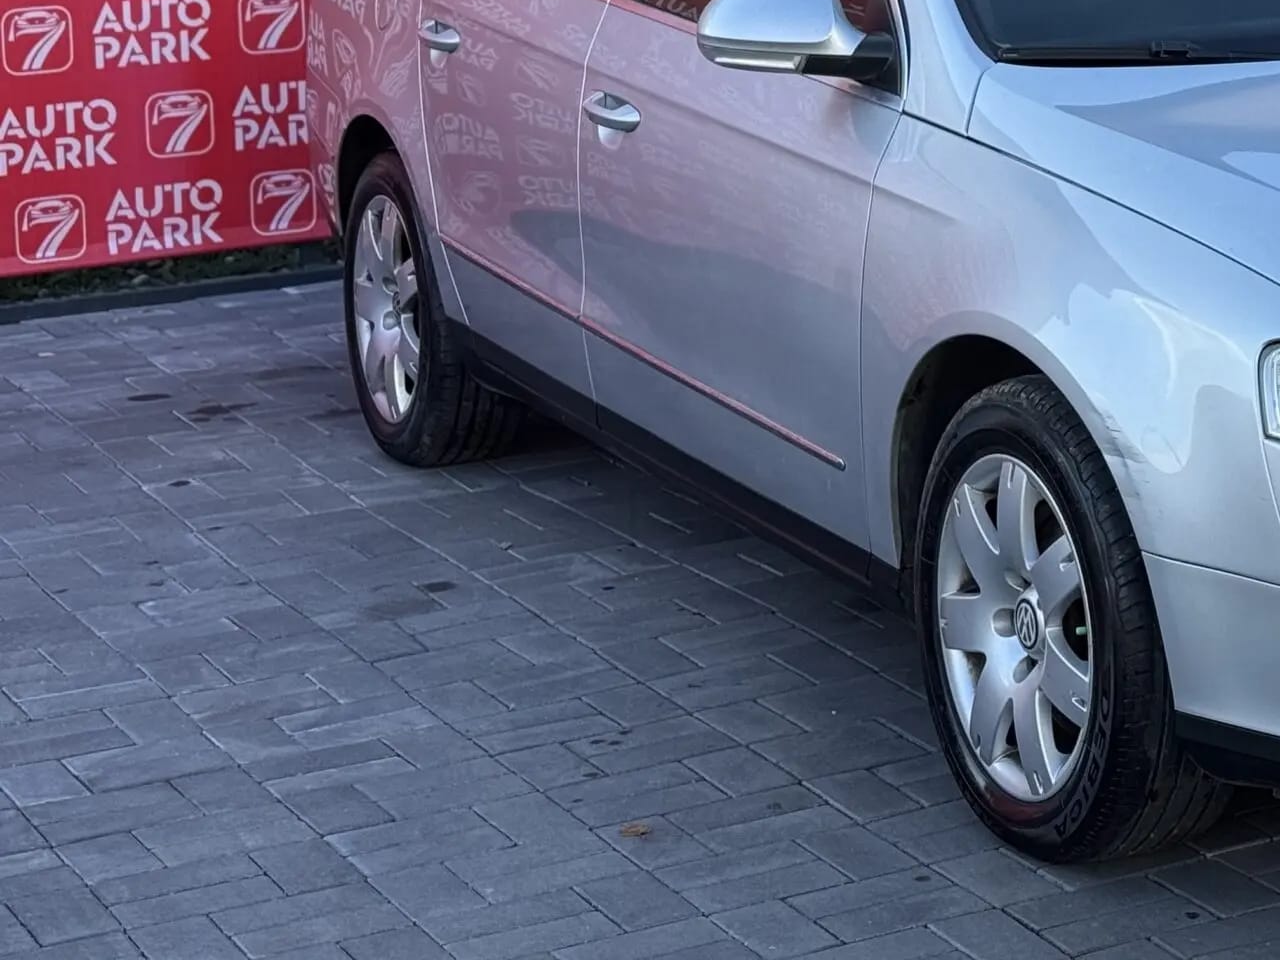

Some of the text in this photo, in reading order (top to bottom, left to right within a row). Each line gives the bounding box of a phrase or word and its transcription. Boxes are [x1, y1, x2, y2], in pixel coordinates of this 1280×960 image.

[94, 27, 211, 69] PARK
[0, 98, 117, 139] AUTO
[232, 81, 306, 117] AUT
[234, 114, 308, 151] PAR
[0, 132, 117, 176] PARK
[105, 179, 223, 222] AUTO
[107, 212, 224, 261] PARK
